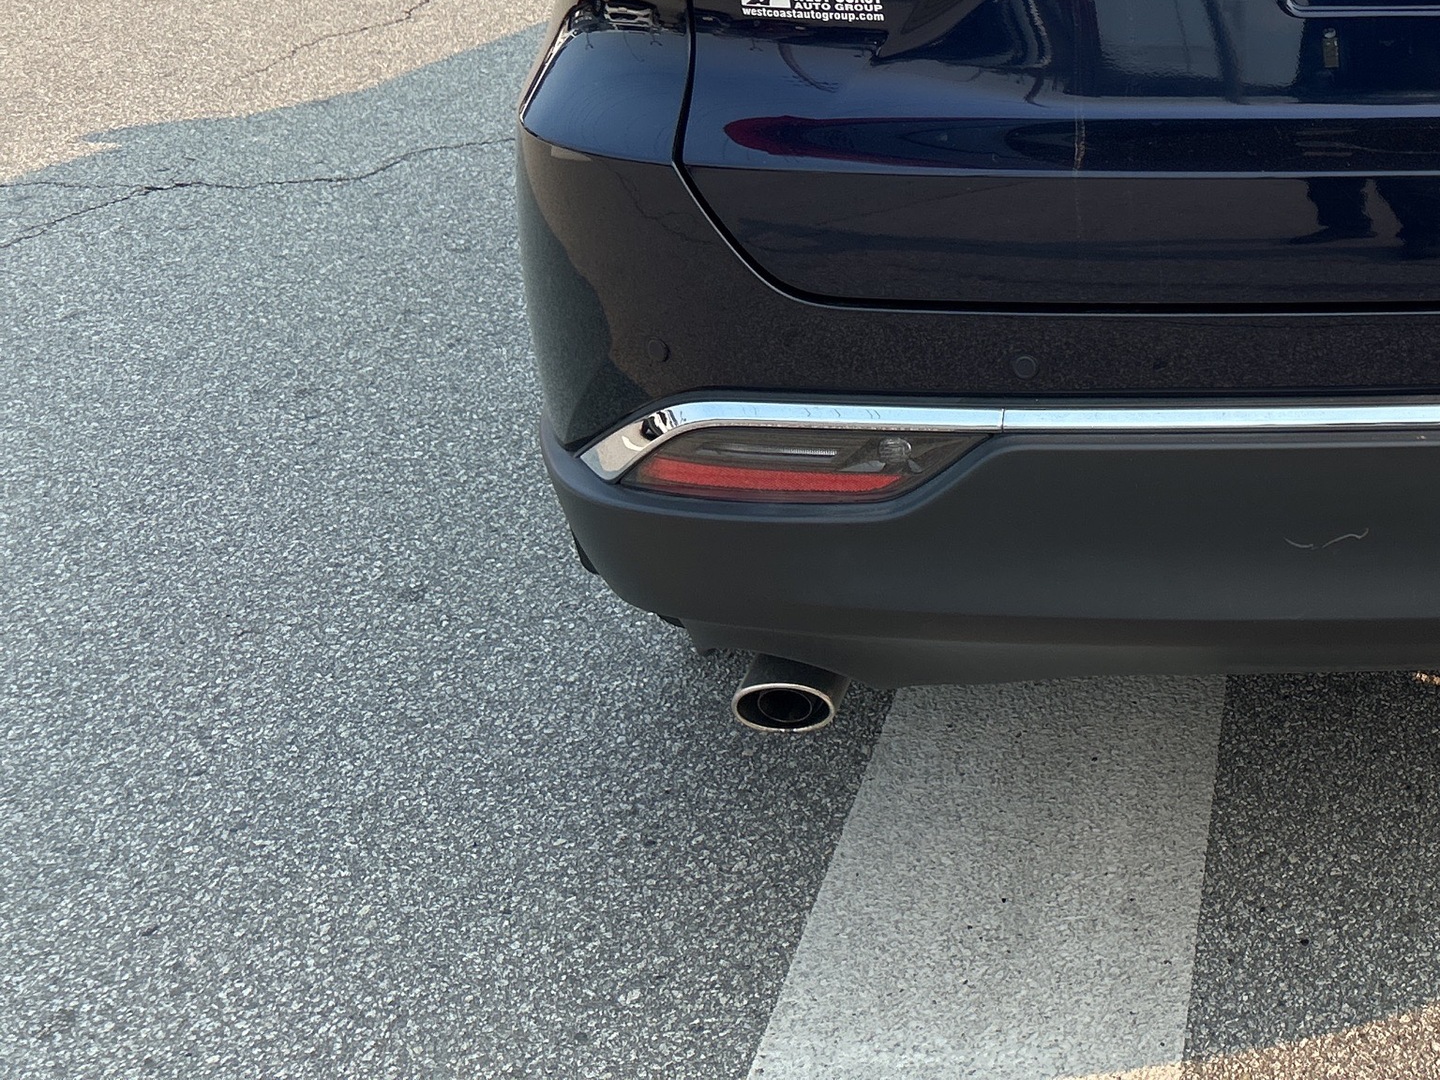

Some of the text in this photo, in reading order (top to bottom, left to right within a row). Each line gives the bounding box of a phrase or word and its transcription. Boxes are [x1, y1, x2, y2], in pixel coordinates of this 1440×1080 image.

[794, 2, 883, 12] AUTO GROUP
[742, 7, 885, 22] westcoastautogroup.com
